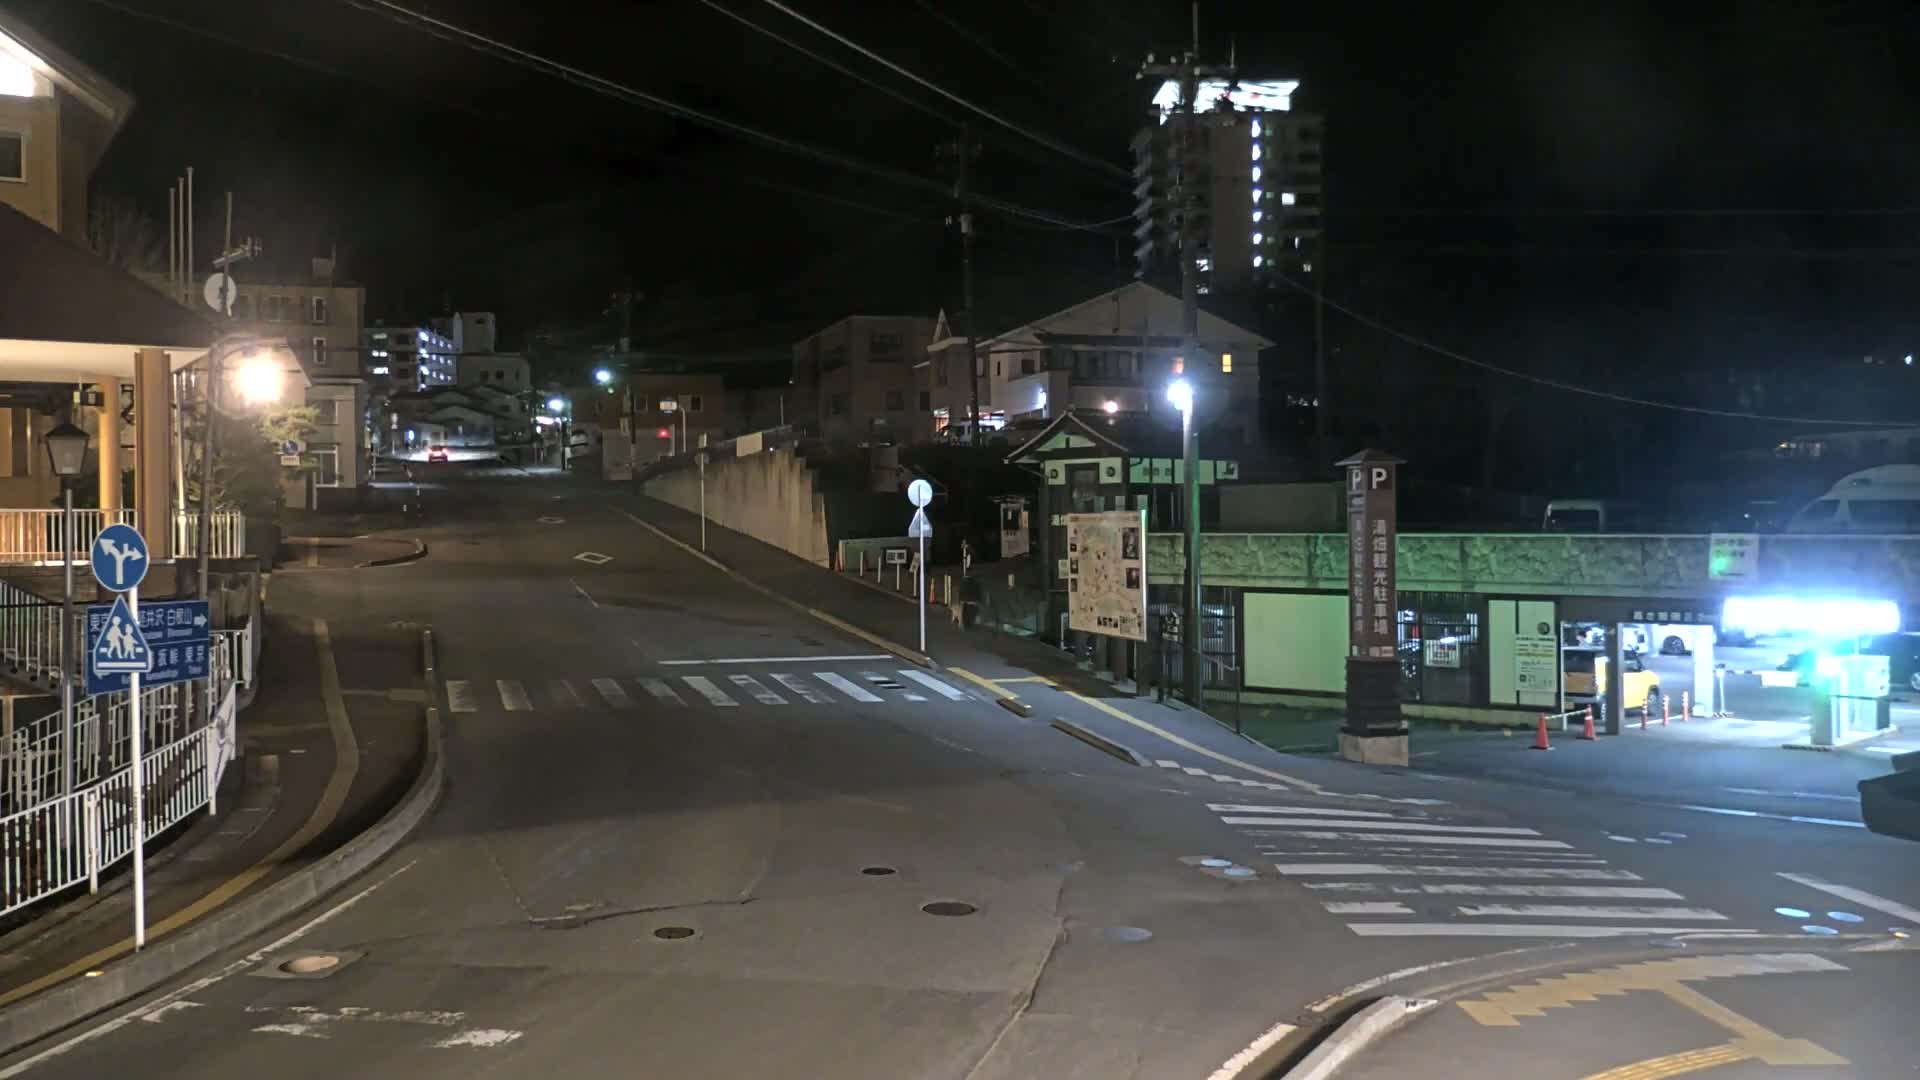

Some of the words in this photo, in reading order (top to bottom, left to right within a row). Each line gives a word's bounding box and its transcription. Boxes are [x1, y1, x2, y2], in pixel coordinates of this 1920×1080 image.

[1351, 469, 1362, 489] P
[1371, 467, 1388, 489] P
[1372, 519, 1389, 635] 湯畑観光駐車場
